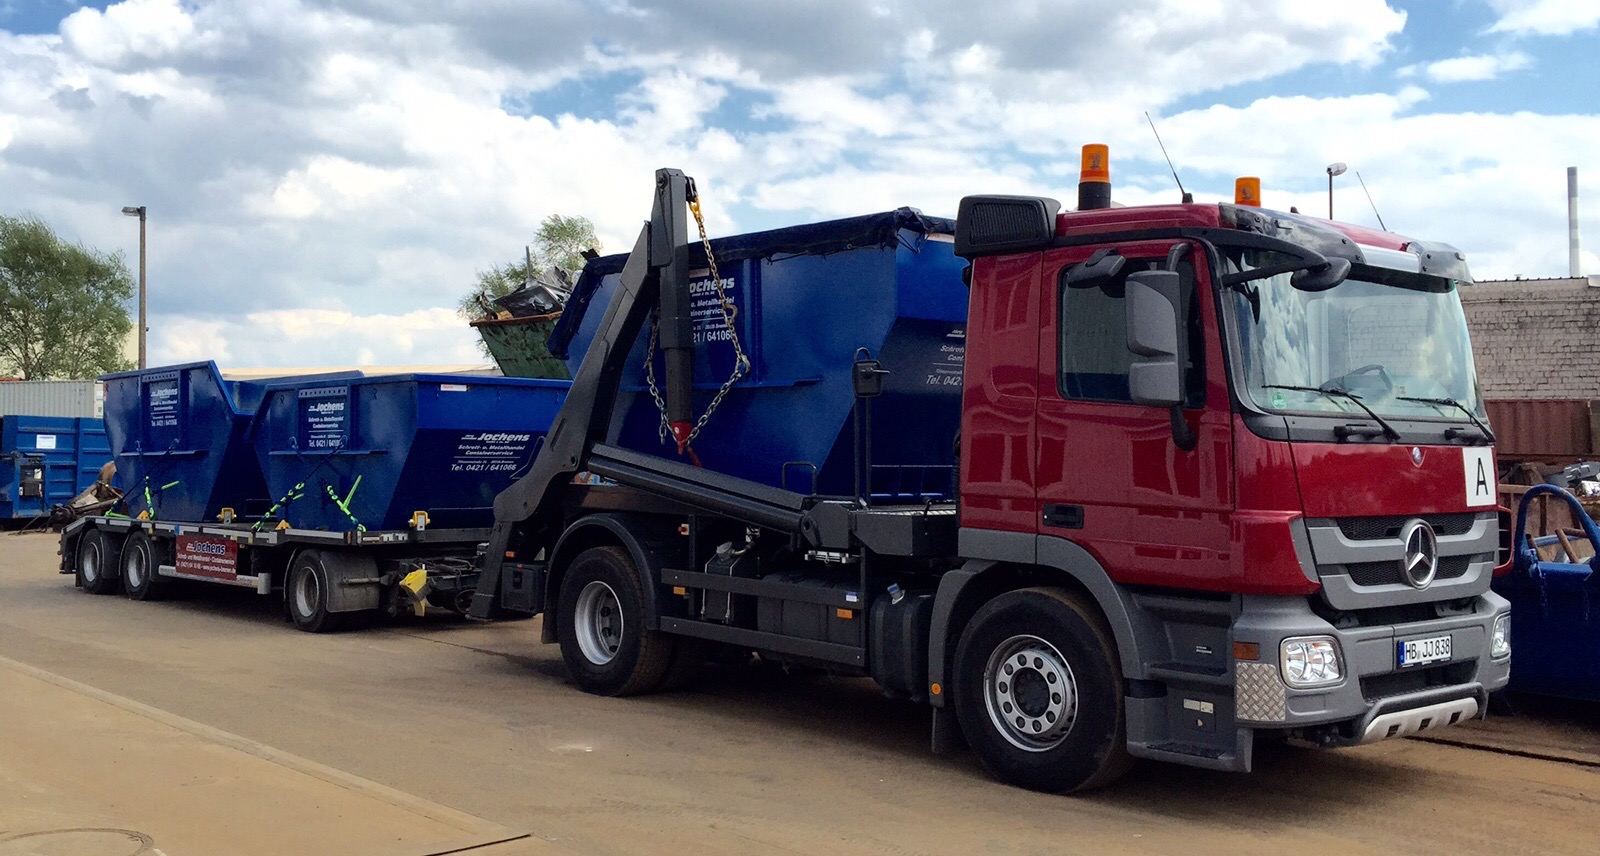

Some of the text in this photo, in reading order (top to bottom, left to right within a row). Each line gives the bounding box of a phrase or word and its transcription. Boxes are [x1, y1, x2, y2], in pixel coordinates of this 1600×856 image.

[689, 277, 735, 293] ochens
[697, 297, 735, 307] Metallhadel
[707, 329, 732, 341] 64106
[926, 375, 942, 385] Tel.
[317, 402, 345, 411] Jochens
[477, 433, 531, 442] Jochens
[451, 464, 464, 472] Tel.
[466, 464, 484, 472] 0421
[1476, 457, 1489, 496] A
[194, 541, 226, 555] Jochens
[1405, 643, 1418, 660] HB
